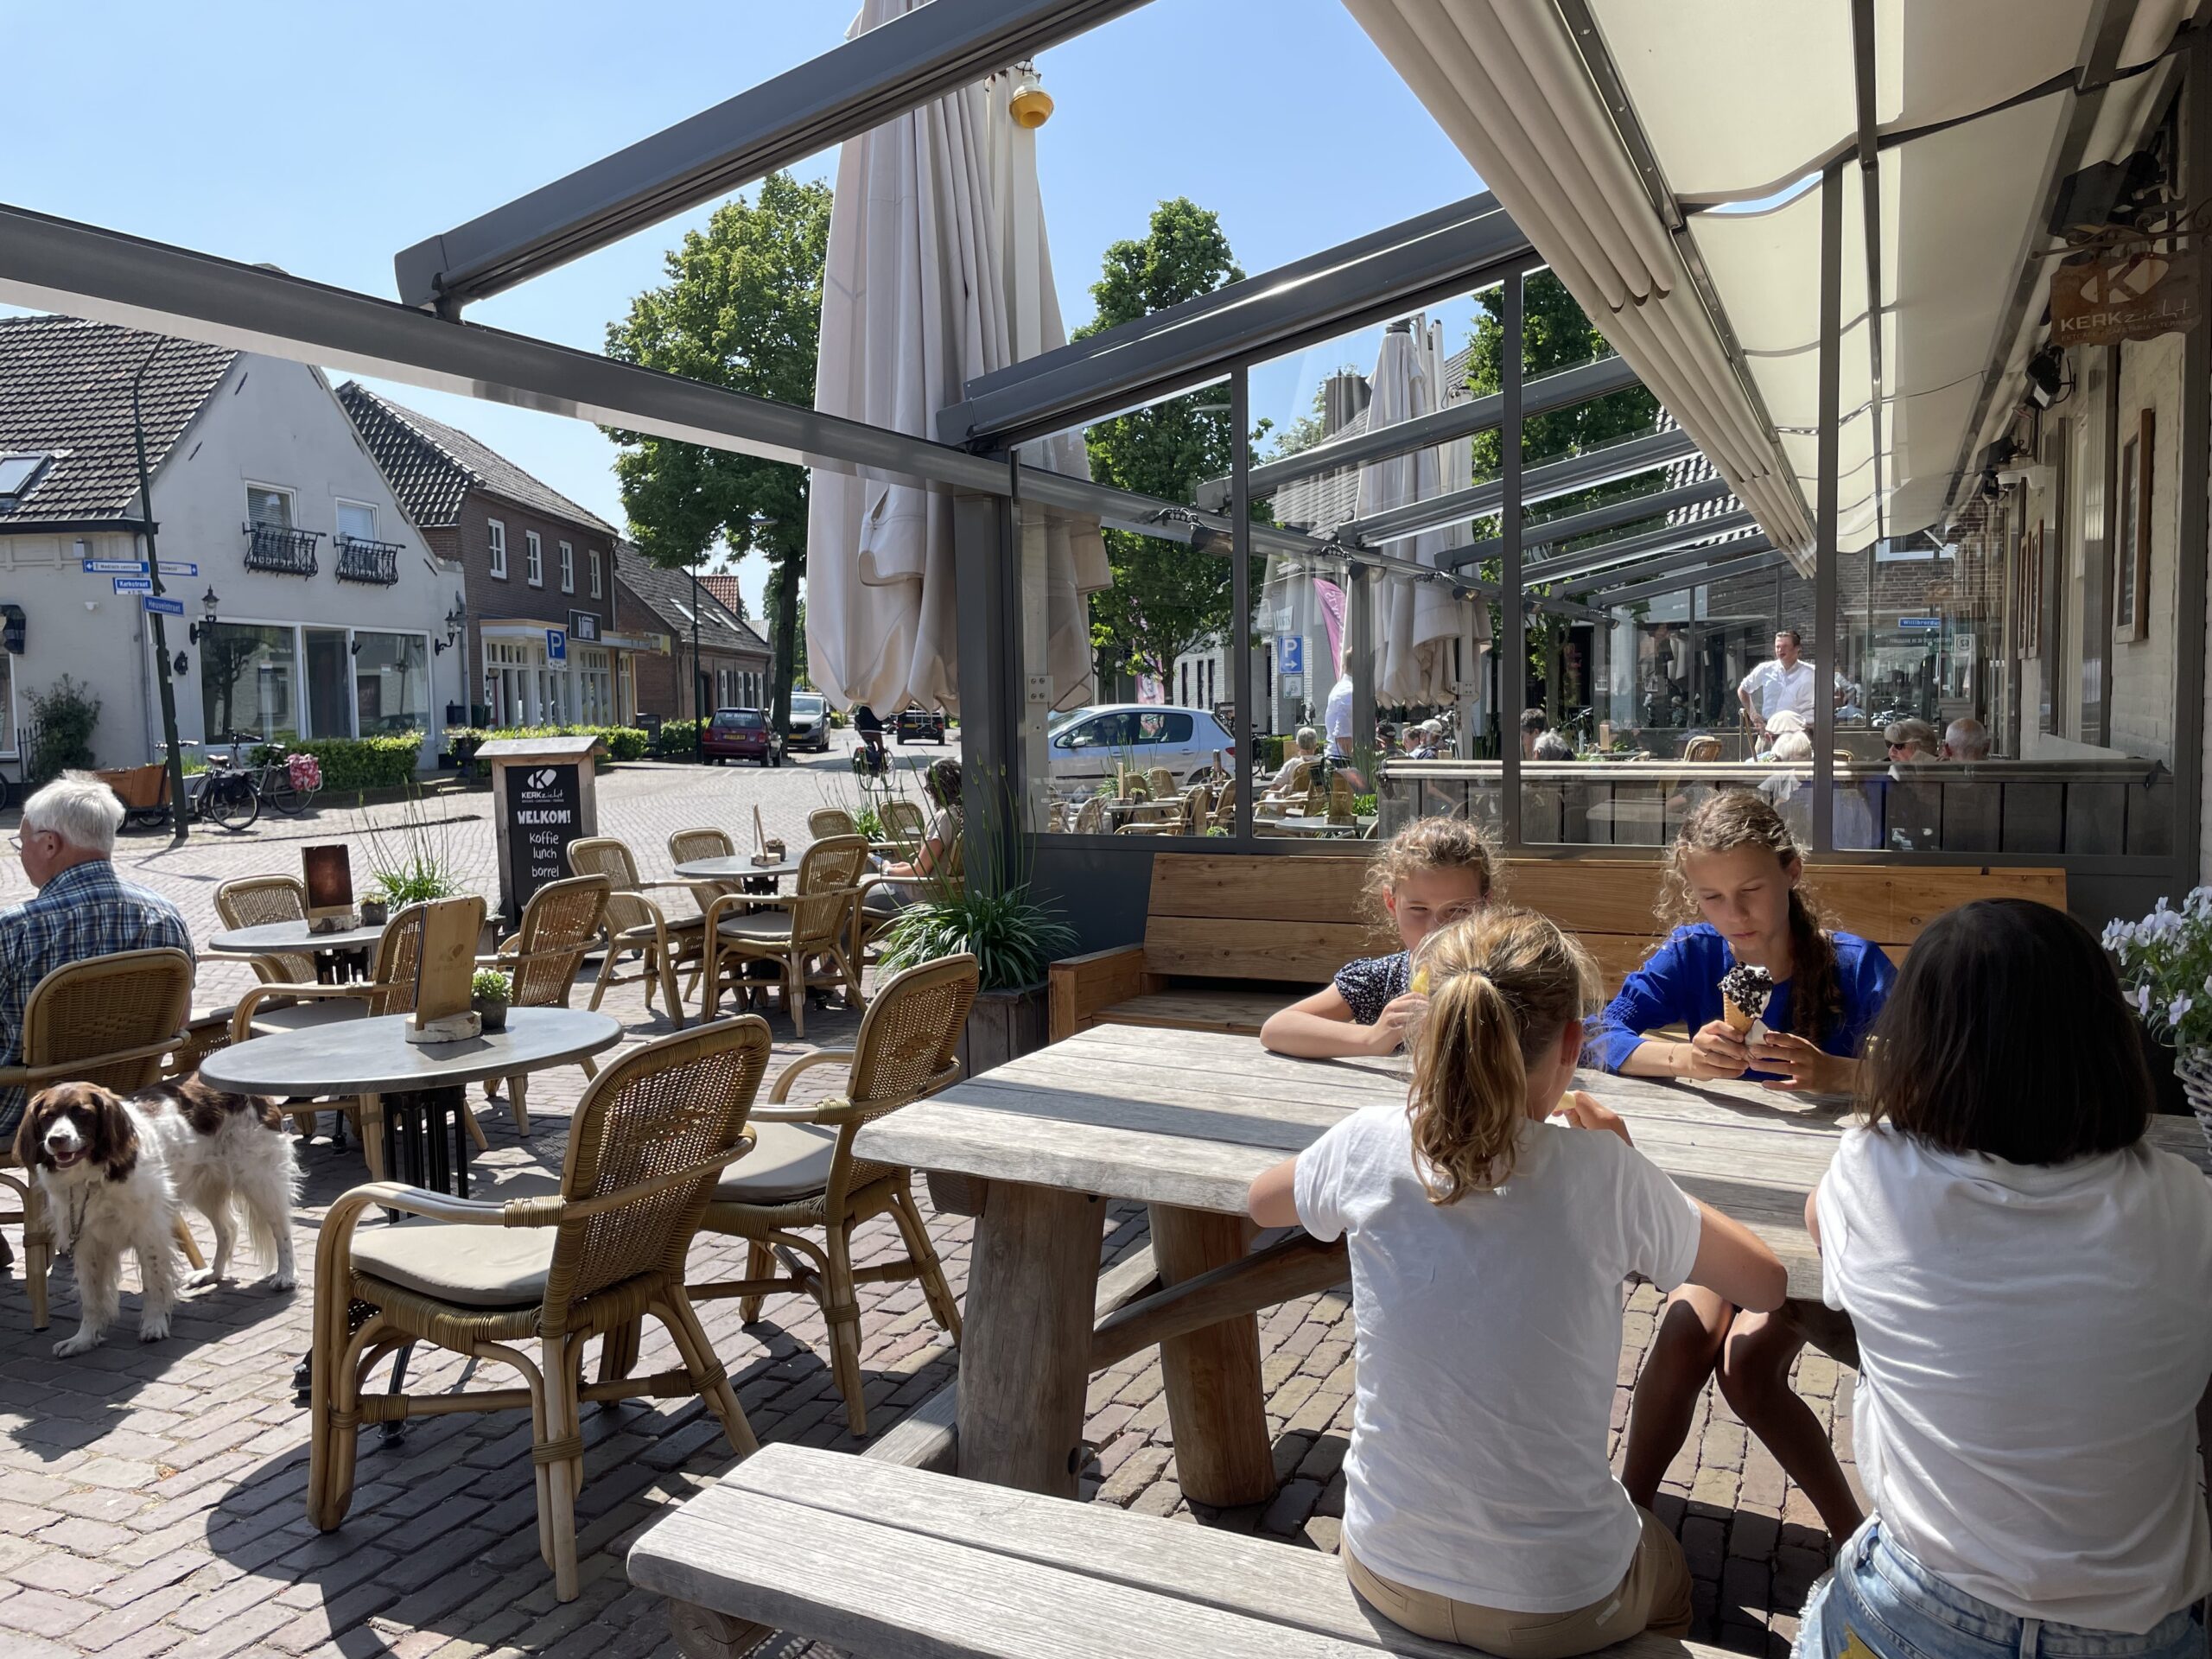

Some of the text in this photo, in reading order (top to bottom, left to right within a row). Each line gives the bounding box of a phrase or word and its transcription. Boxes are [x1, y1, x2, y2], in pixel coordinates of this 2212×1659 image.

[2061, 298, 2192, 332] KERKzicht
[148, 600, 181, 613] Heuvelstraat
[550, 632, 563, 657] P
[1285, 639, 1298, 658] P
[521, 788, 563, 799] KERKzicht
[517, 810, 571, 824] WELKOM!
[533, 846, 557, 860] lunch
[531, 865, 559, 878] borrel
